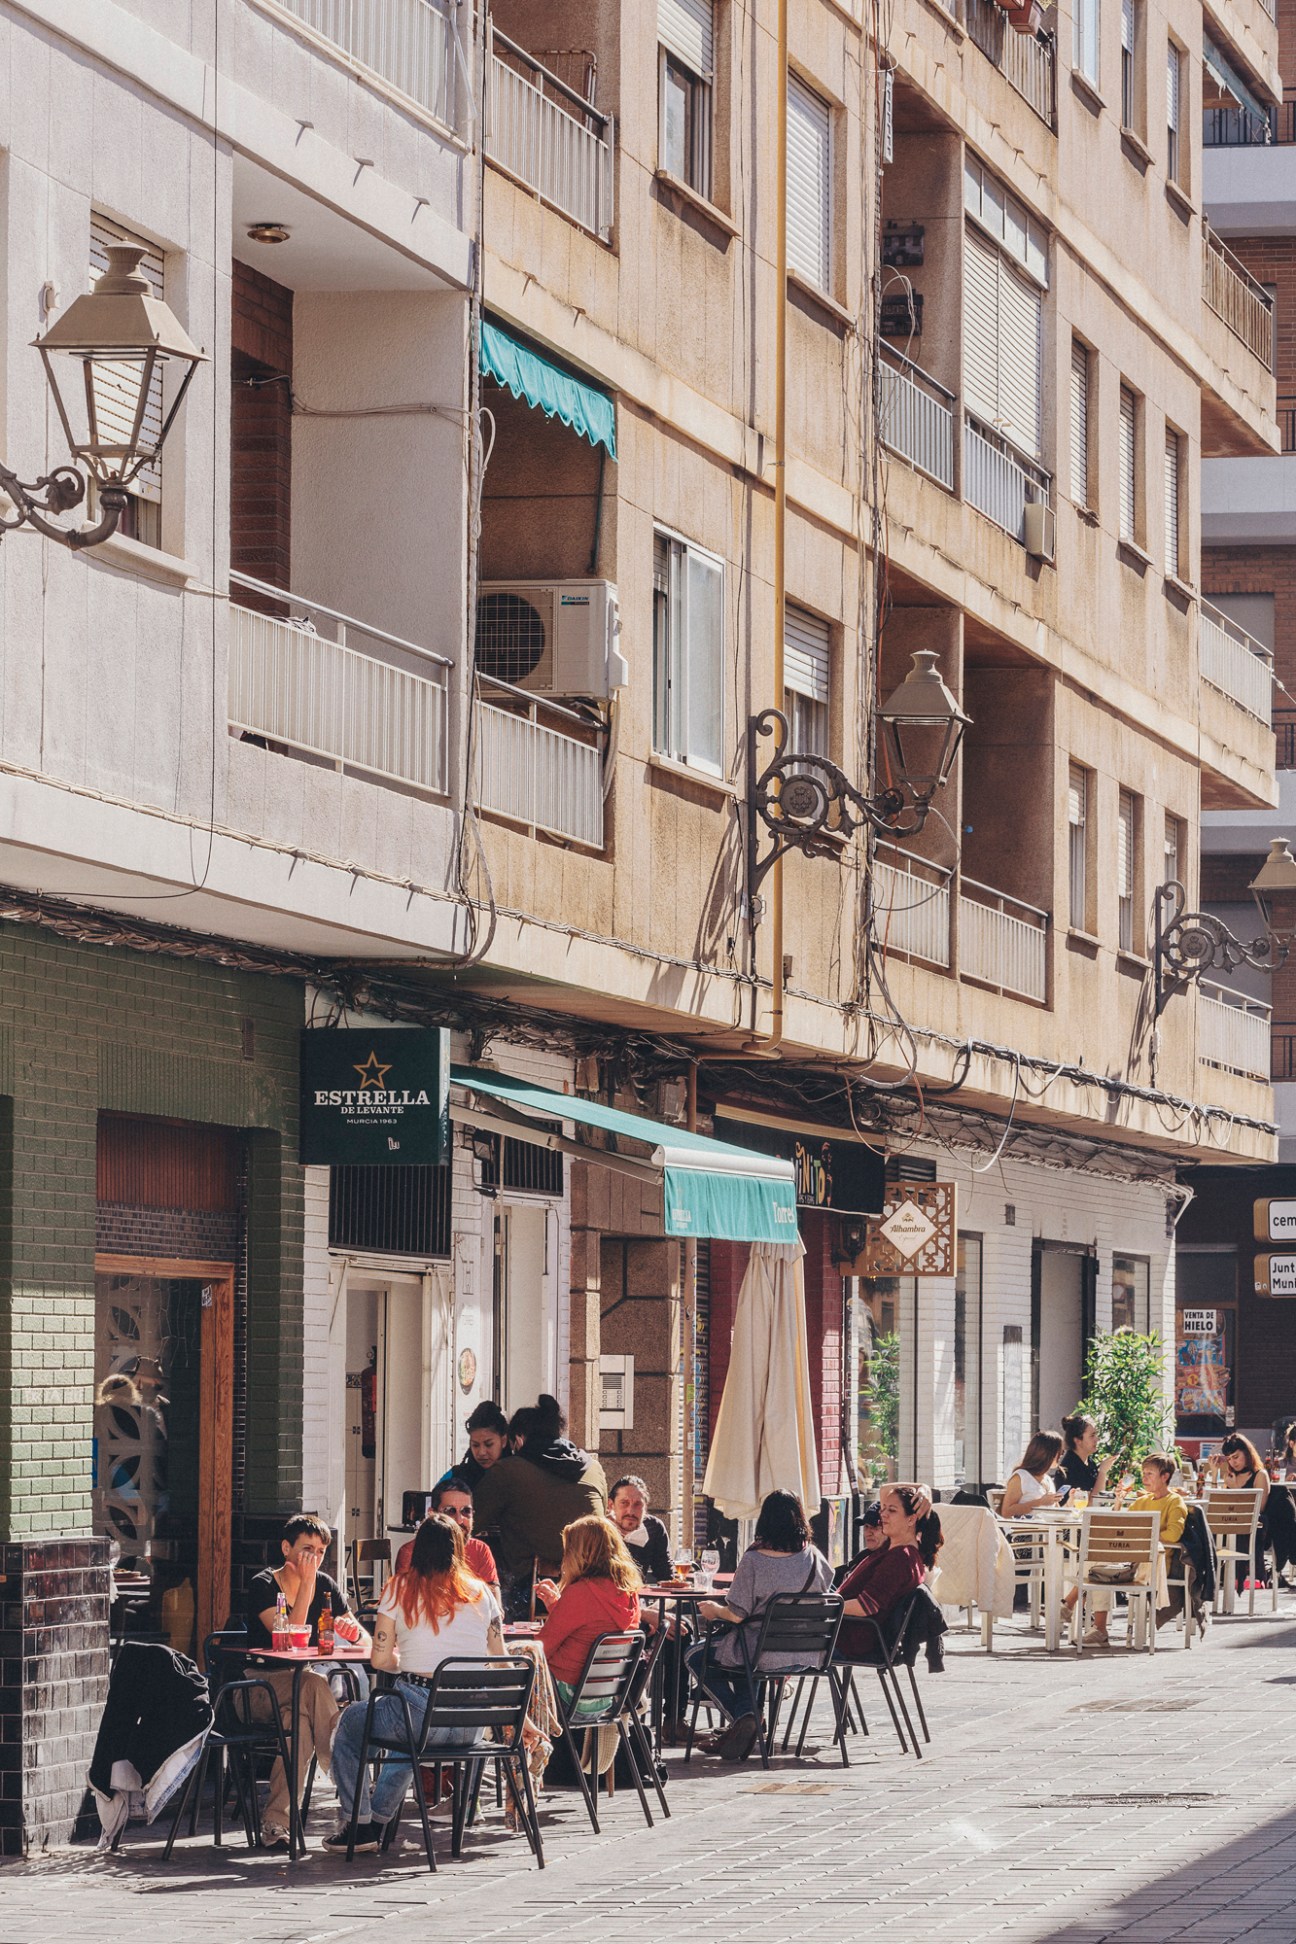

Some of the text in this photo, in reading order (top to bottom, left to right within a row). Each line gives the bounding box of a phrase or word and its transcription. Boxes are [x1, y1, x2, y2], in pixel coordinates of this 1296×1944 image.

[314, 1090, 430, 1105] ESTRELLA
[341, 1106, 404, 1114] DE LEVANTE
[890, 1224, 927, 1233] Alhambra
[1184, 1311, 1214, 1319] VENTA DE
[1184, 1321, 1214, 1331] HIELO
